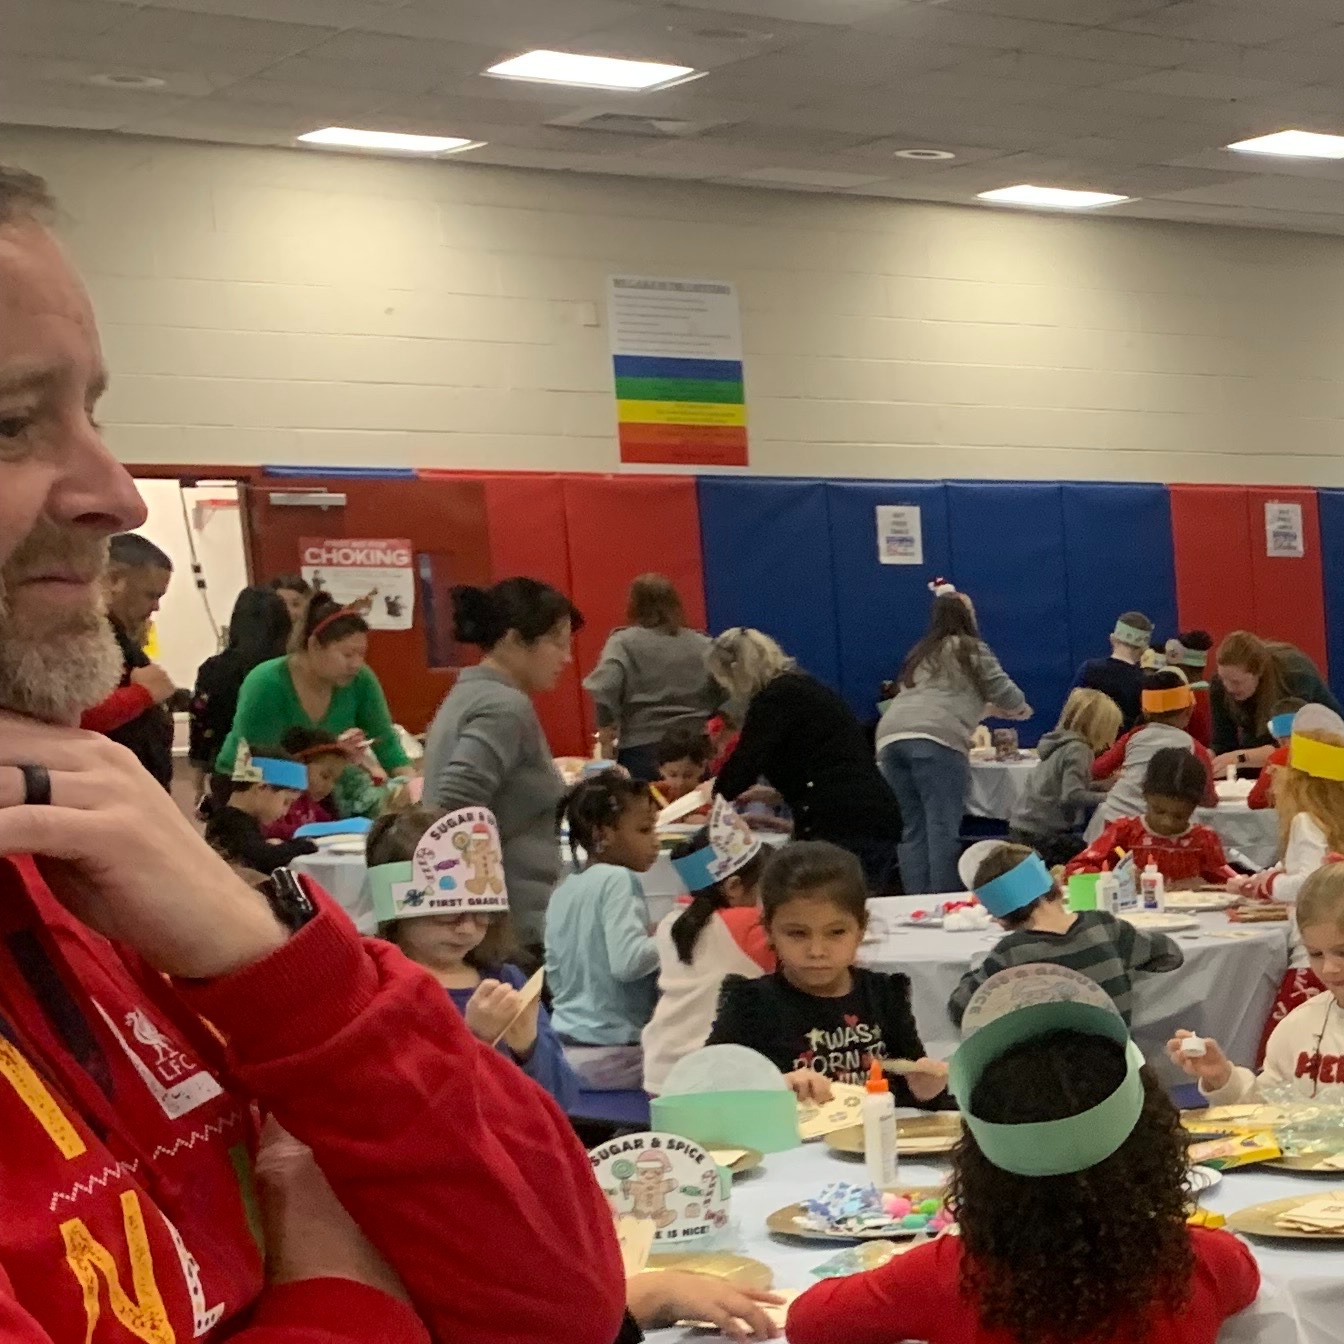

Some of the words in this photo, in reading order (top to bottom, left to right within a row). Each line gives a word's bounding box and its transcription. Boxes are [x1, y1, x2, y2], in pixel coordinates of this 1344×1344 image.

[304, 547, 409, 566] CHOKING
[430, 812, 474, 841] SUGAR
[428, 898, 462, 908] FIRST
[468, 897, 500, 906] GRADE
[824, 1023, 873, 1050] WAS
[157, 1052, 197, 1081] LFC
[590, 1138, 644, 1167] SUGAR
[651, 1137, 661, 1148] &
[666, 1139, 706, 1164] SPICE
[667, 1229, 677, 1239] IS
[682, 1225, 710, 1237] NICE!
